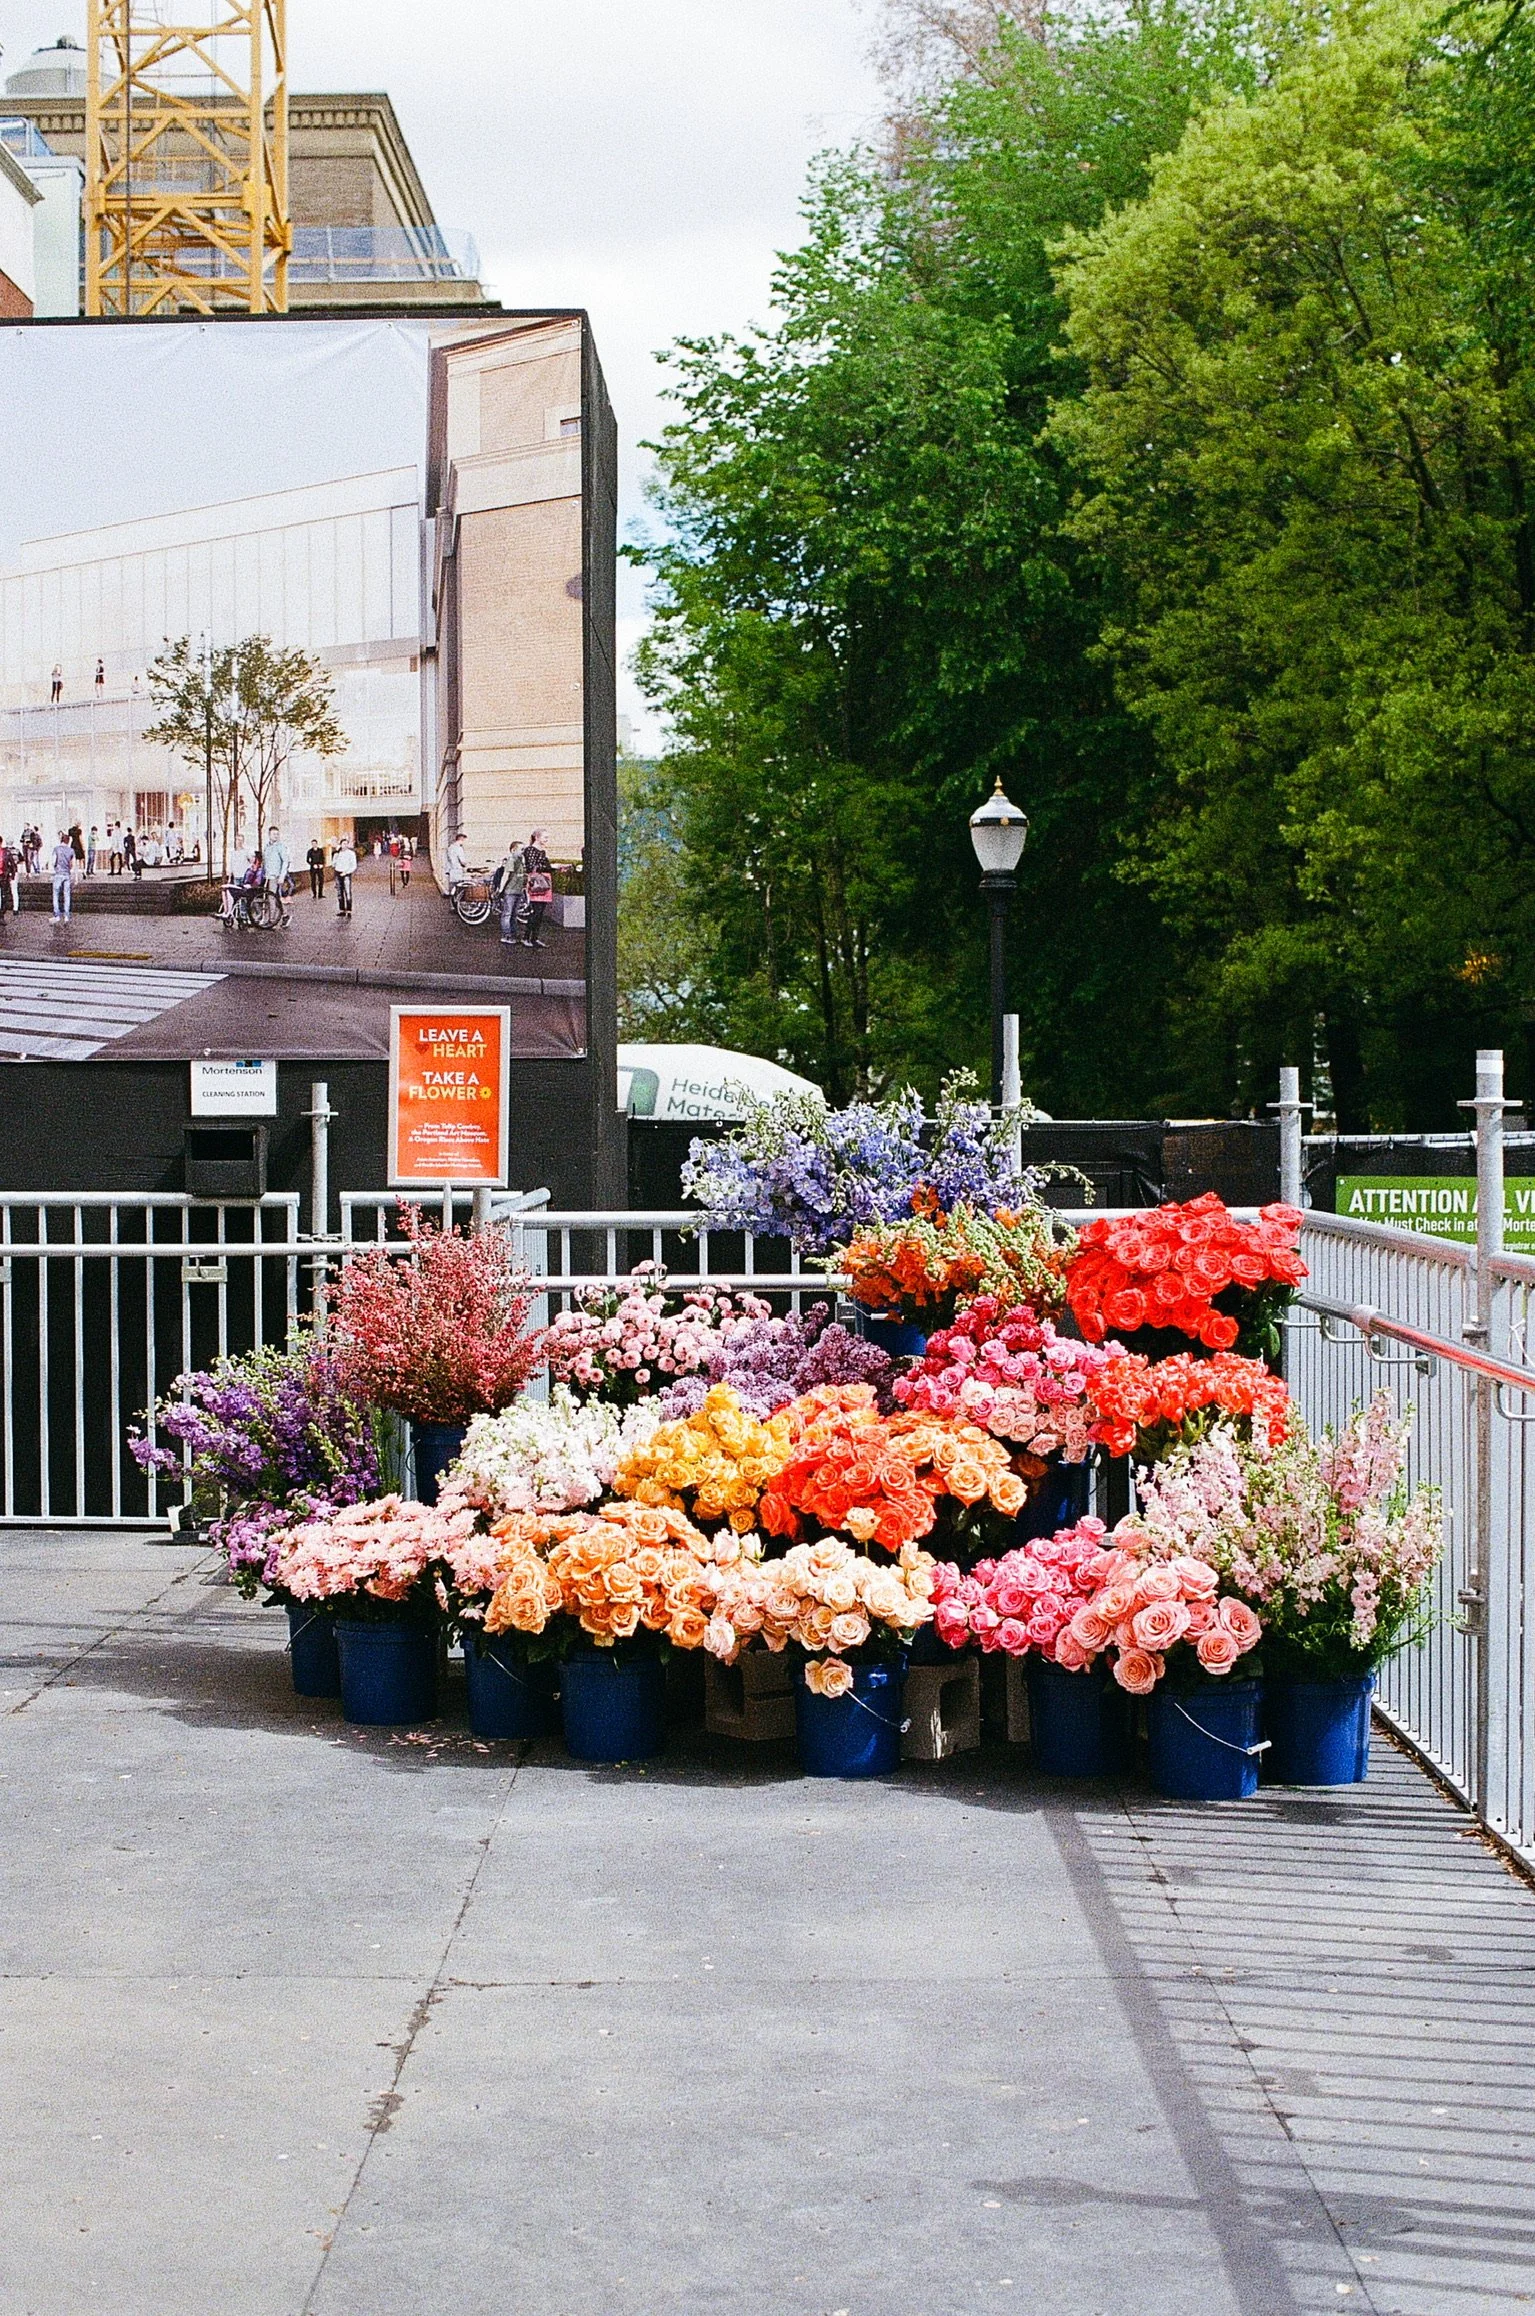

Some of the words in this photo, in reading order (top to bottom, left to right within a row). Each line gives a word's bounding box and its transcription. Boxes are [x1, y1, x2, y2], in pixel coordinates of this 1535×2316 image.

[419, 1029, 468, 1042] LEAVE
[471, 1029, 484, 1042] A
[433, 1044, 488, 1058] HEART
[202, 1066, 263, 1075] Mortenson
[422, 1072, 464, 1085] TAKE
[468, 1072, 480, 1085] A
[409, 1086, 477, 1101] FLOWER
[1348, 1189, 1468, 1213] ATTENTION
[1415, 1217, 1452, 1233] Check
[1453, 1217, 1465, 1232] in
[1467, 1217, 1478, 1232] at
